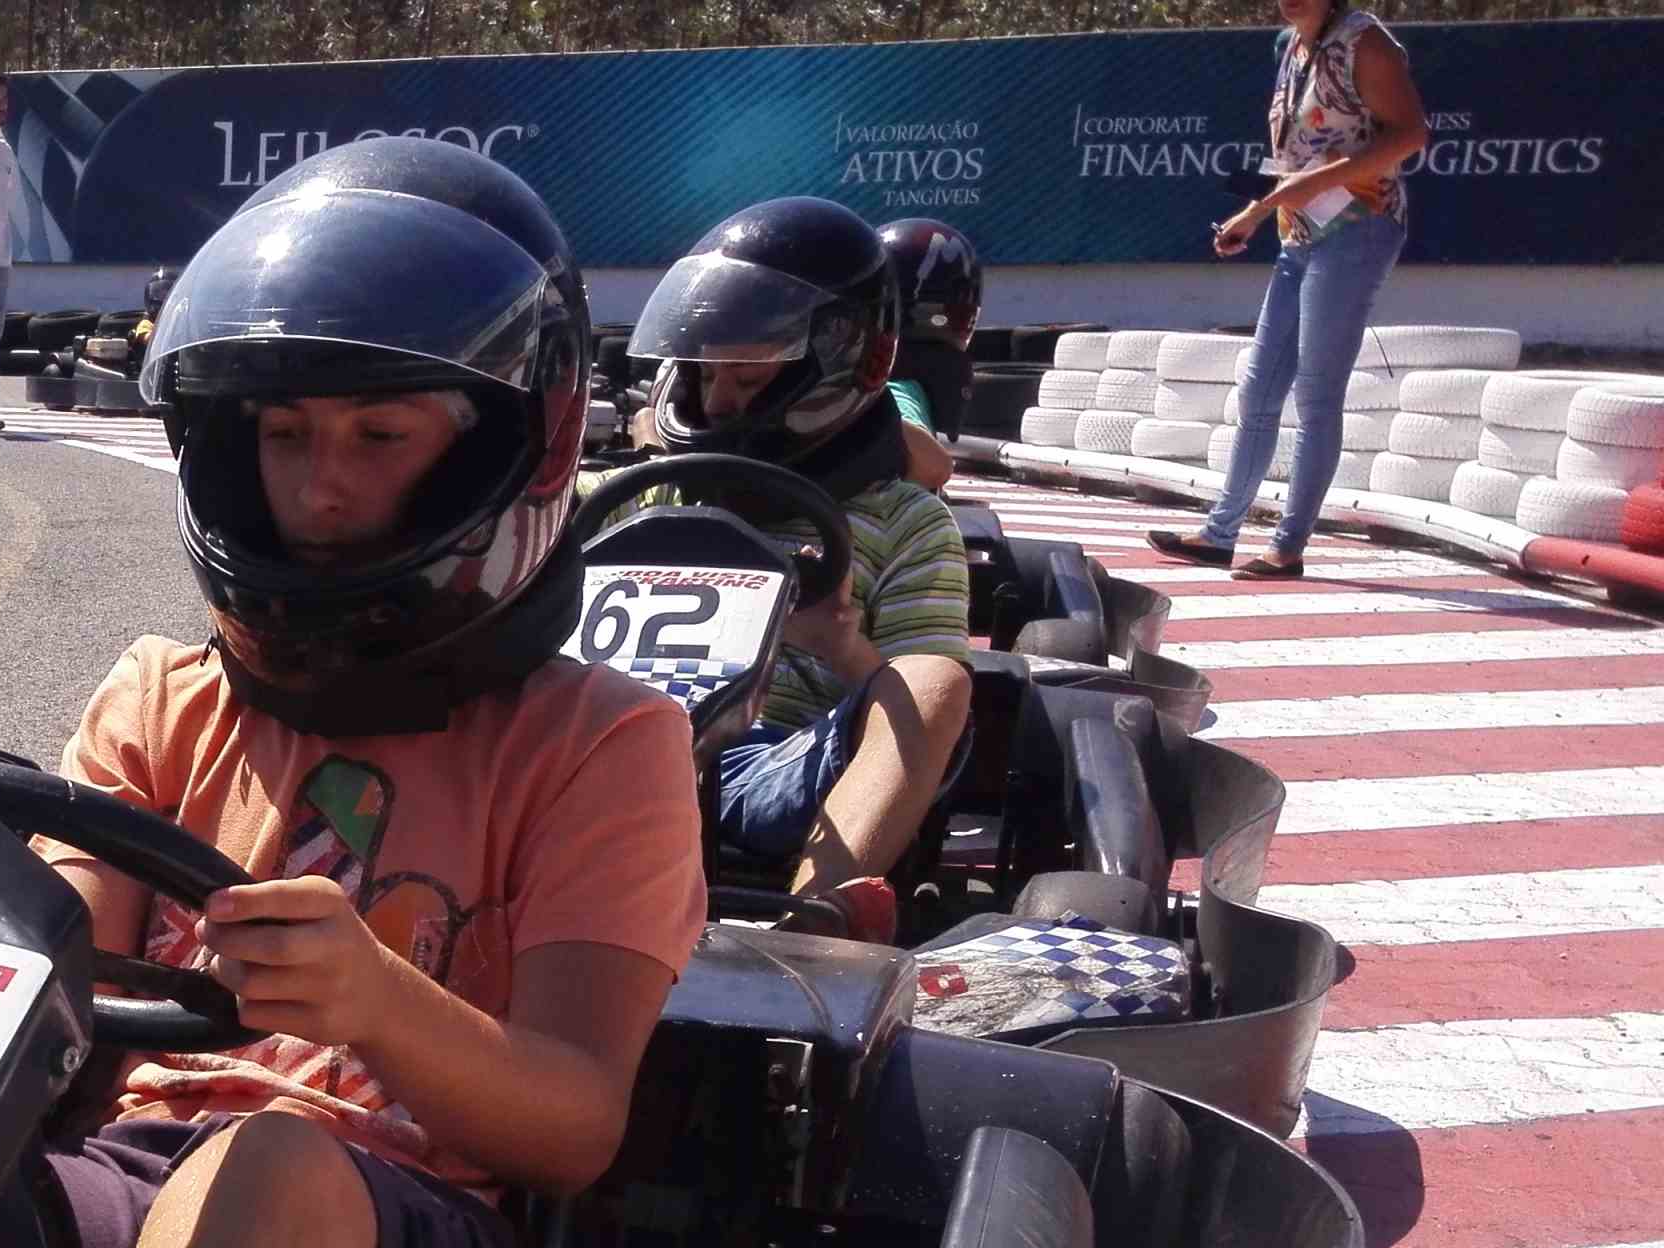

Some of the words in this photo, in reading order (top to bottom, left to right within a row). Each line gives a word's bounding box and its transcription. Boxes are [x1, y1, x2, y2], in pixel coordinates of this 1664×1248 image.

[847, 120, 979, 143] VALORIZAÇÃO
[1084, 116, 1208, 135] CORPORATE
[840, 148, 985, 184] ATIVOS
[1399, 137, 1603, 176] OGISTICS
[581, 578, 720, 663] 62
